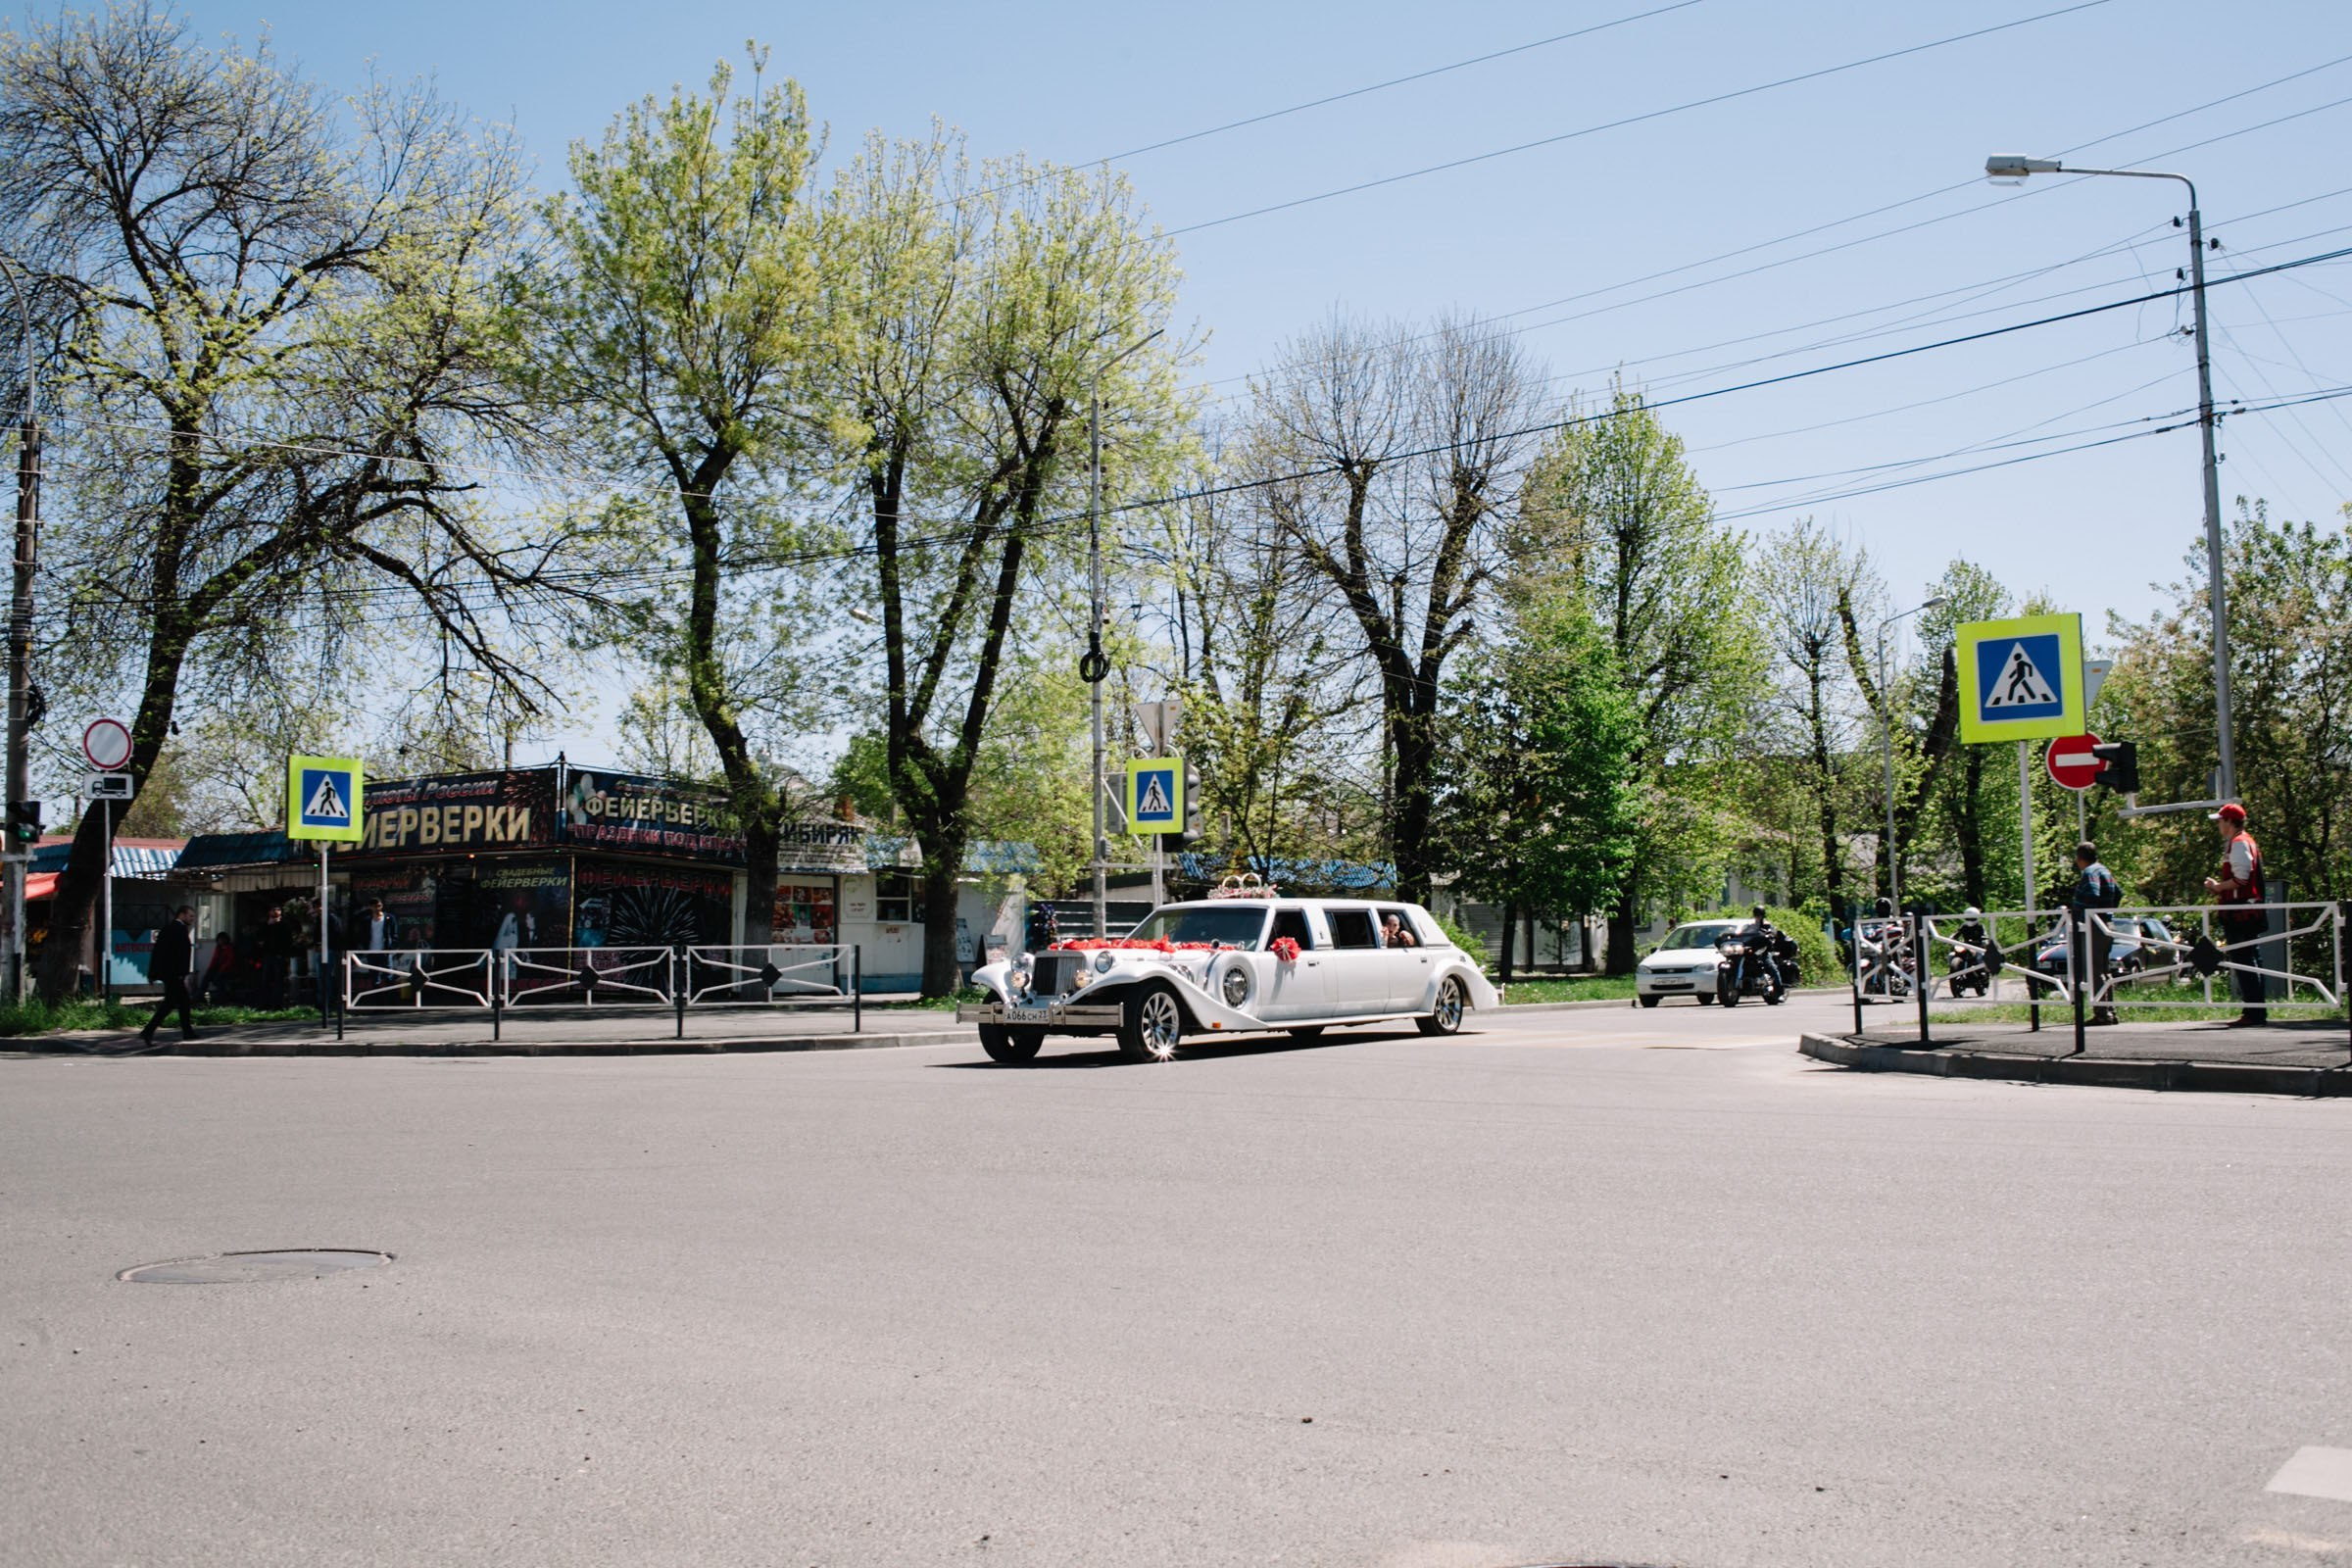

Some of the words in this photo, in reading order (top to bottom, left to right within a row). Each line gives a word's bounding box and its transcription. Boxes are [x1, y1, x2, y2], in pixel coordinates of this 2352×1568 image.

[422, 779, 499, 801] России
[585, 792, 737, 830] ФЕЙЕРВЕРК
[311, 805, 531, 852] ЙЕРВЕРКИ
[781, 822, 862, 844] ИБИРЯК
[663, 831, 699, 851] ПОД
[479, 876, 568, 889] ФЕЙЕРВЕРКИ
[495, 866, 556, 878] СВАДЕБНЫЕ
